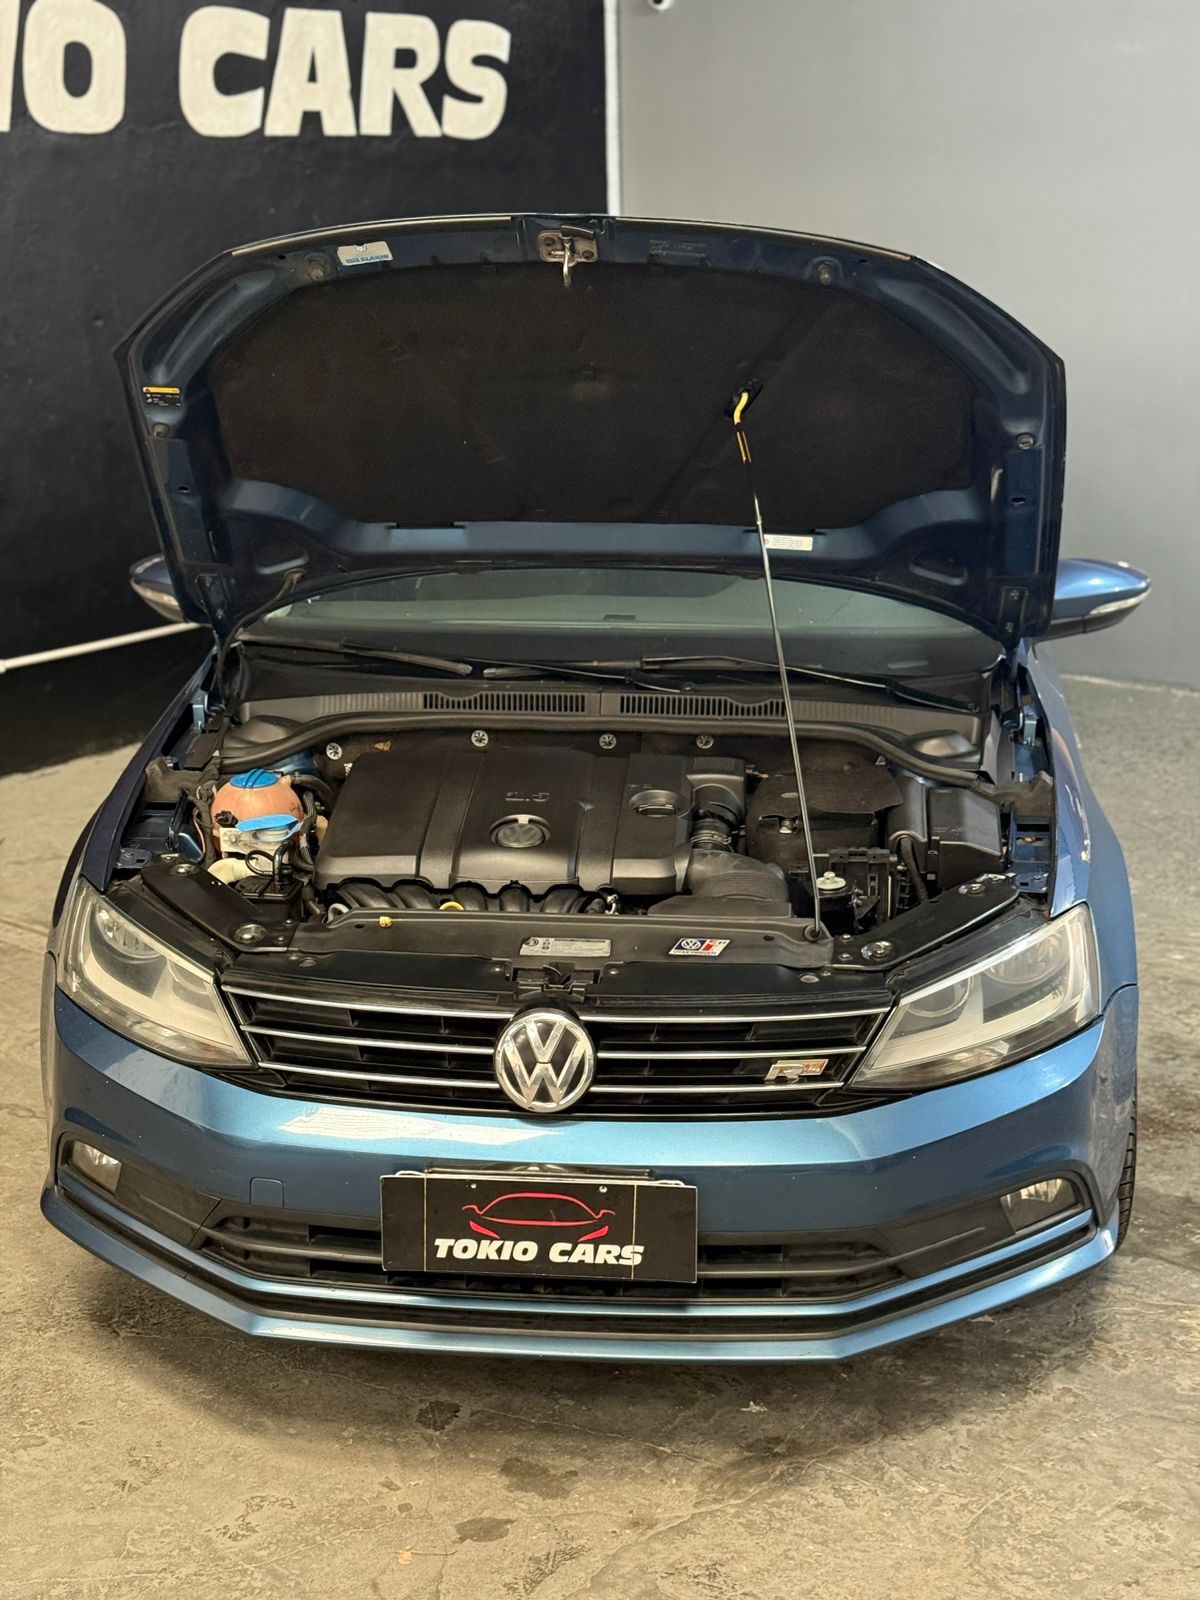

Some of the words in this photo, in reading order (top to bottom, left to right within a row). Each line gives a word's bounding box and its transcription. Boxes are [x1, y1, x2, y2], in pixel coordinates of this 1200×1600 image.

[179, 5, 512, 140] CARS
[501, 1018, 589, 1108] VW
[434, 1238, 539, 1262] TOKIO
[548, 1242, 645, 1266] CARS
